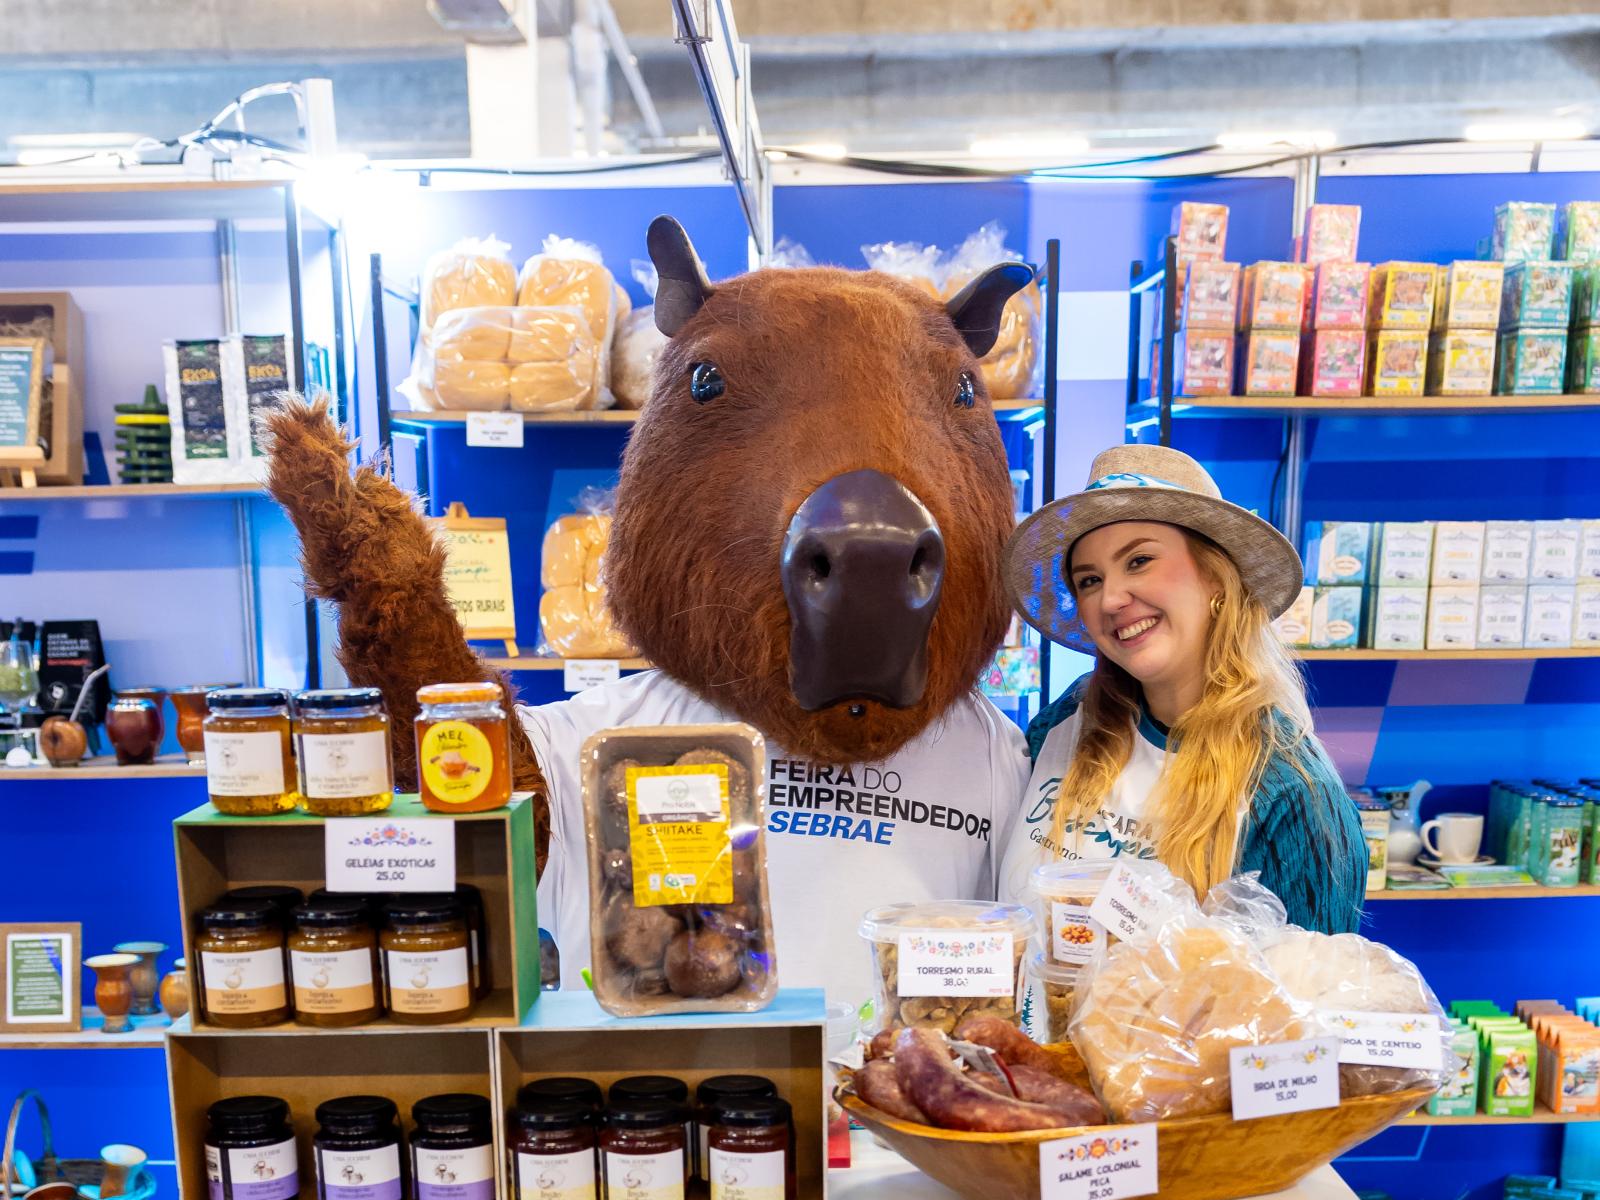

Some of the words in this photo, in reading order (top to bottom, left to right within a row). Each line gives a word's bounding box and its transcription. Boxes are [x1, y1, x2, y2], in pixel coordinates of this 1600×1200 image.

[437, 730, 465, 742] MEL
[770, 759, 857, 788] FEIRA
[864, 767, 902, 794] DO
[769, 783, 991, 842] EMPREENDEDOR
[768, 810, 896, 846] SEBRAE
[1110, 897, 1139, 924] TORRESMO
[917, 966, 963, 975] TORRESMO
[967, 966, 995, 975] RURAL
[1366, 1039, 1377, 1047] DE
[1381, 1040, 1422, 1050] CENTEIO
[1253, 1080, 1276, 1092] BROA
[1279, 1079, 1289, 1089] DE
[1291, 1075, 1318, 1087] MILHO
[1059, 1168, 1093, 1183] SALAME
[1096, 1159, 1142, 1175] COLONIAL
